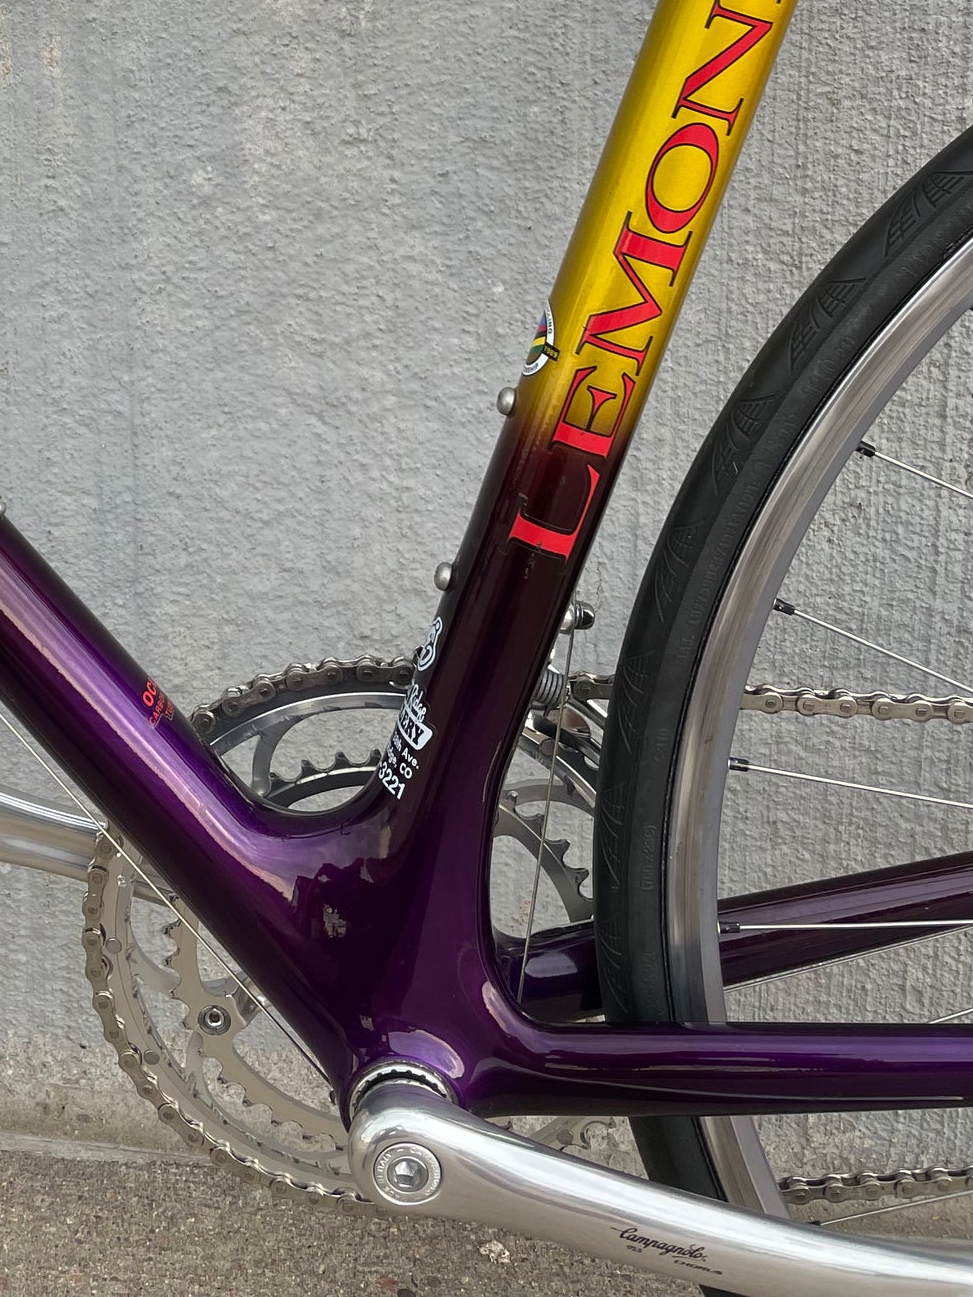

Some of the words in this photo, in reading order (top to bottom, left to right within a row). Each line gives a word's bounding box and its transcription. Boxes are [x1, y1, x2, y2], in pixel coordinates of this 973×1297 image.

[402, 747, 420, 770] Ave.
[399, 762, 413, 780] CO
[612, 1227, 708, 1262] Campagnolo
